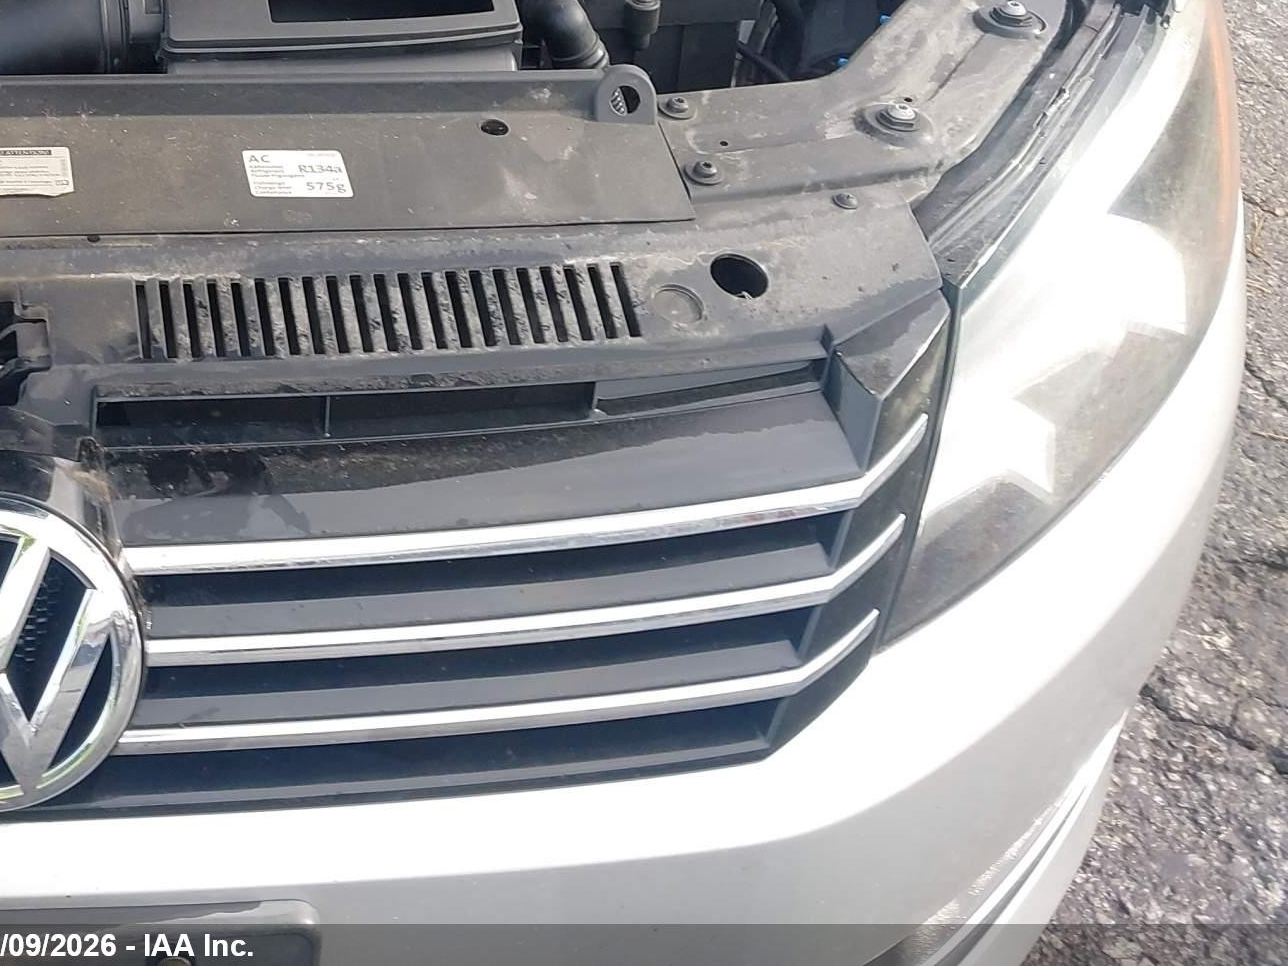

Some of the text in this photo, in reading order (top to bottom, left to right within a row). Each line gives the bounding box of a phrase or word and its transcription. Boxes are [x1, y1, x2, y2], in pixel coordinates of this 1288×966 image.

[249, 154, 270, 163] AC
[298, 164, 343, 174] R134a
[306, 181, 347, 194] 575g
